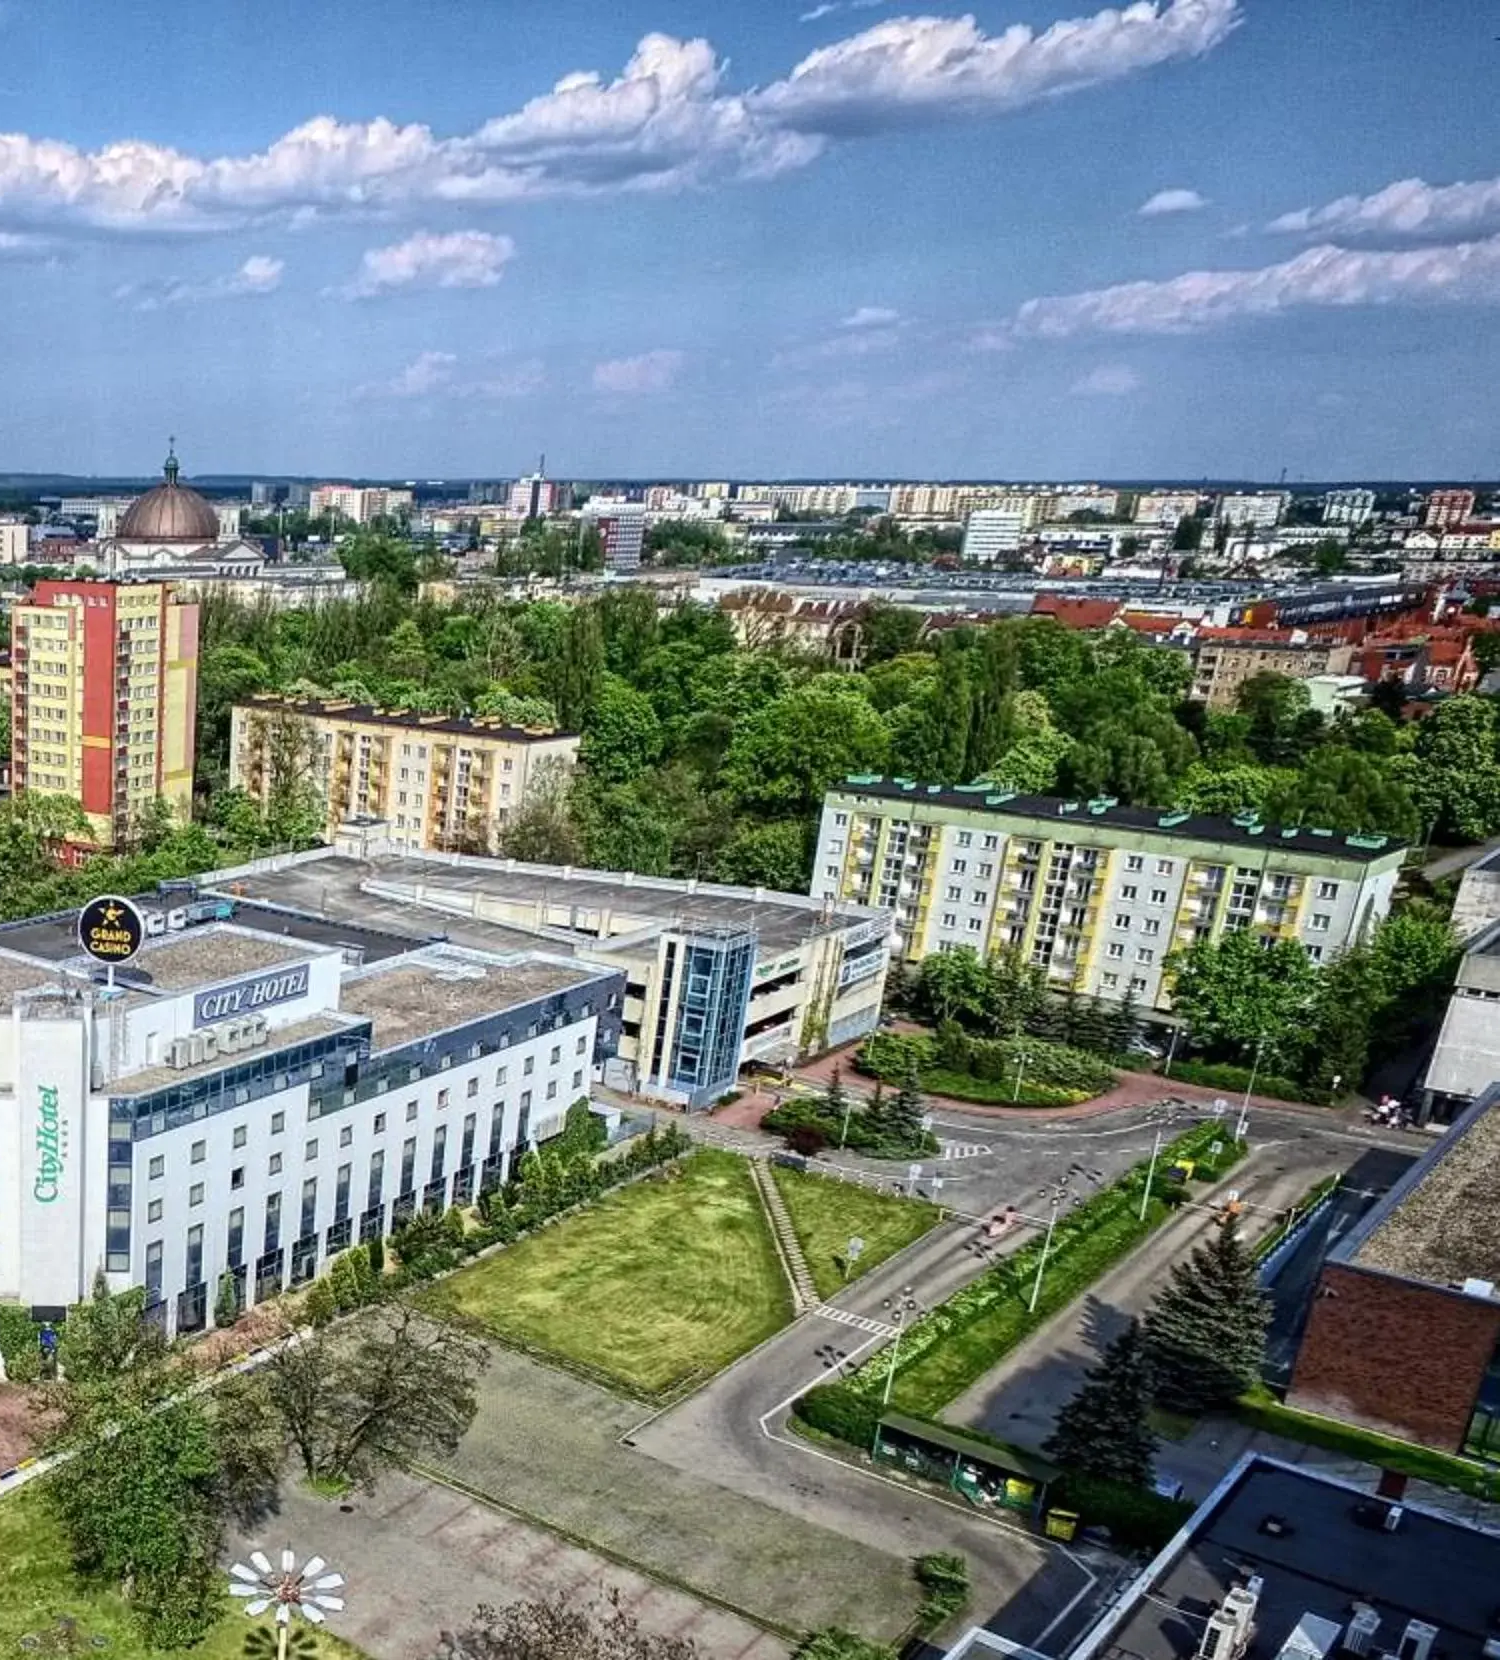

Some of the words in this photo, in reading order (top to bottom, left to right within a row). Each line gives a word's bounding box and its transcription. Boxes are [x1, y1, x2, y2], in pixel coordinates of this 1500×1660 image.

[90, 940, 131, 955] CASINO
[91, 928, 131, 943] GRAND
[202, 986, 248, 1019] CITY
[251, 972, 308, 1006] HOTEL
[34, 1085, 63, 1203] CityHotel
